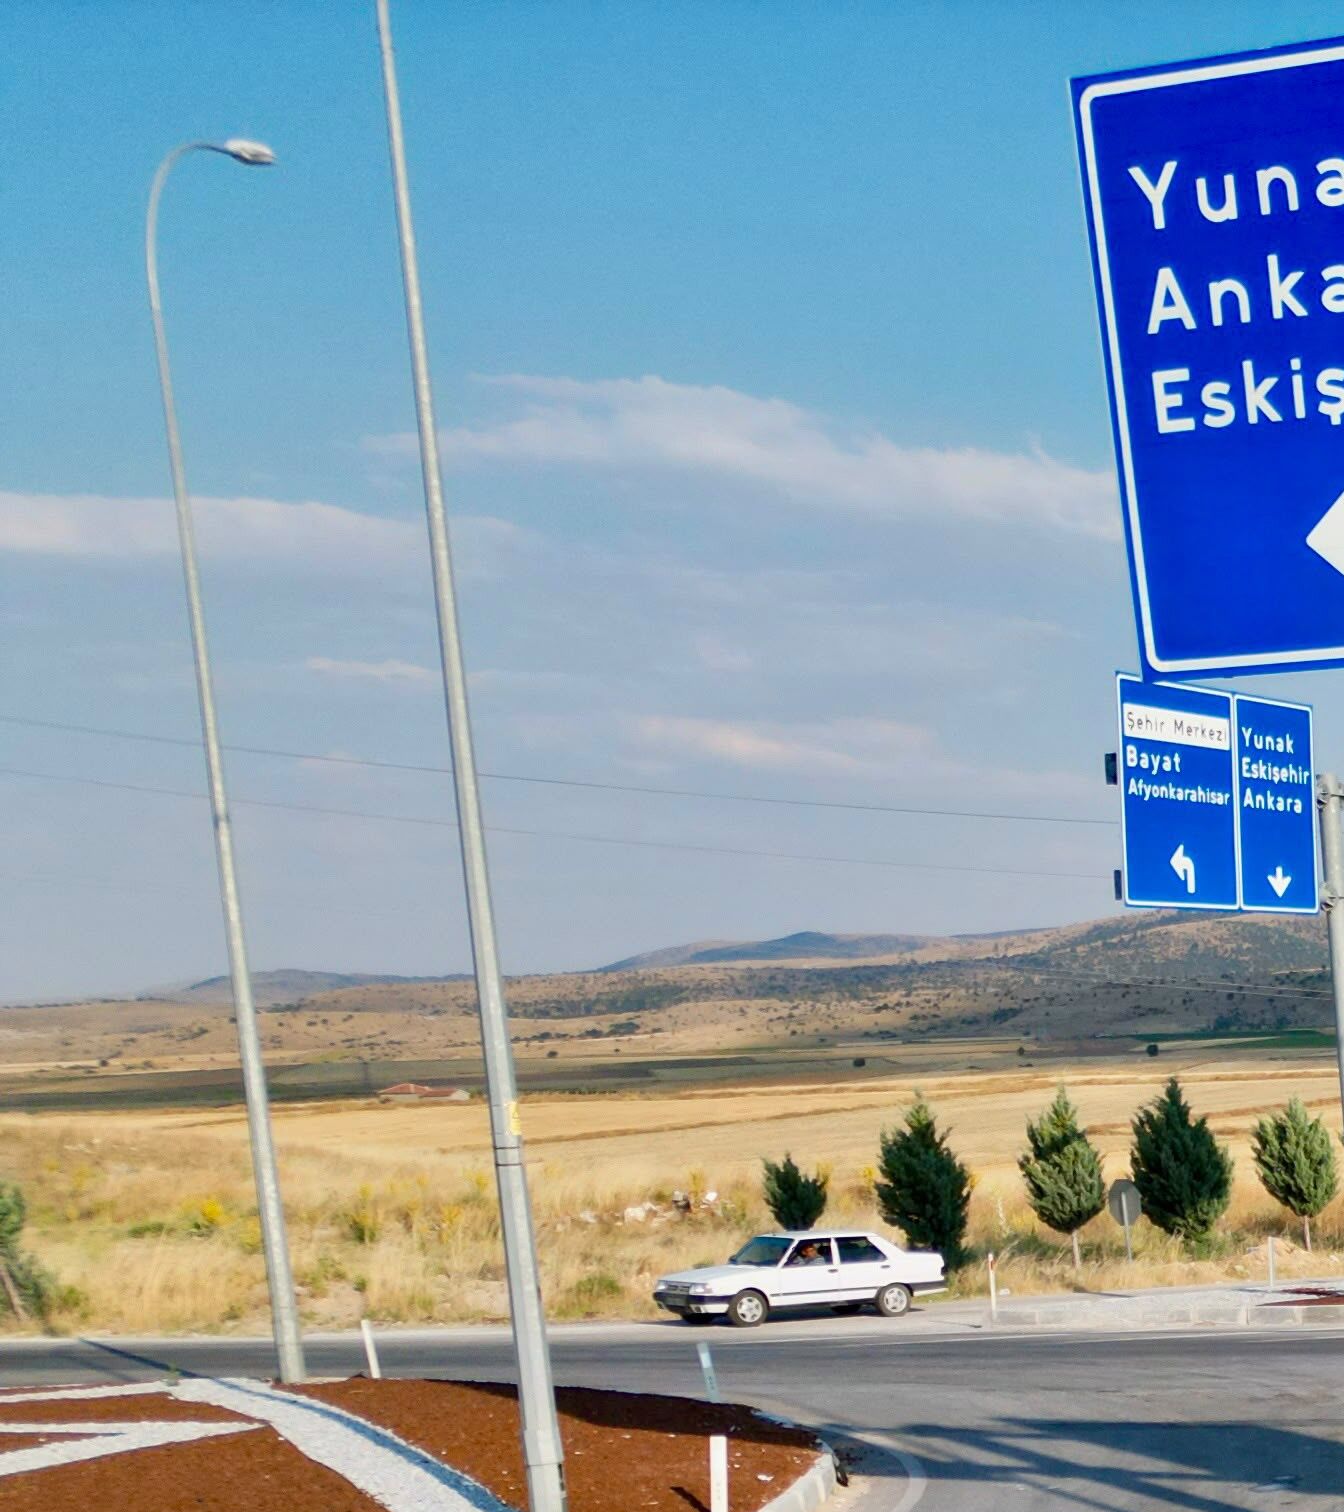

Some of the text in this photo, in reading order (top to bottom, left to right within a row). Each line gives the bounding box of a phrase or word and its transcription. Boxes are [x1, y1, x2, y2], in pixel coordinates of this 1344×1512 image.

[1127, 711, 1227, 743] Şehir Merkezi
[1241, 726, 1294, 754] Yunak
[1126, 744, 1181, 775] Bayat
[1242, 756, 1310, 785] Eskişehir
[1128, 777, 1230, 806] Afyonkarahisar
[1243, 787, 1302, 814] Ankara
